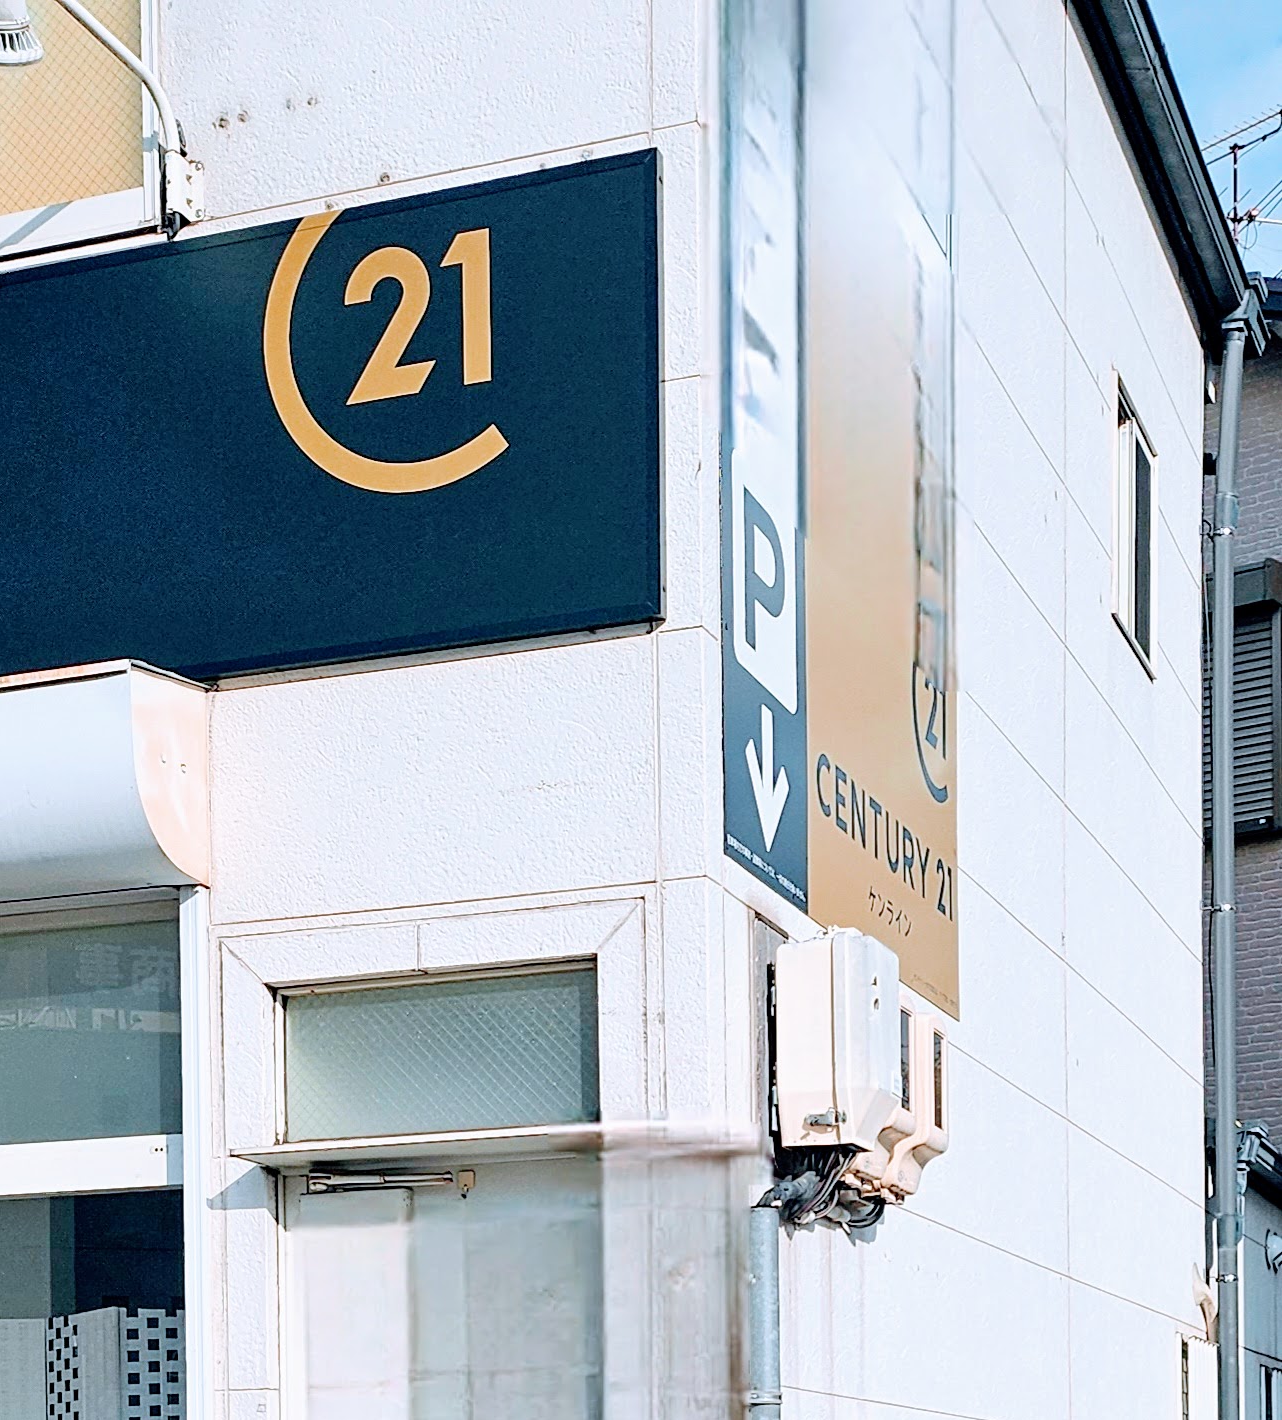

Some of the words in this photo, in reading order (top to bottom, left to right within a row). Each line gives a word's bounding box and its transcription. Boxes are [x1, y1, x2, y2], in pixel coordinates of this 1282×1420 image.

[743, 484, 786, 652] P
[816, 753, 930, 899] CENTURY
[936, 857, 954, 922] 21
[868, 885, 913, 938] ケンライン
